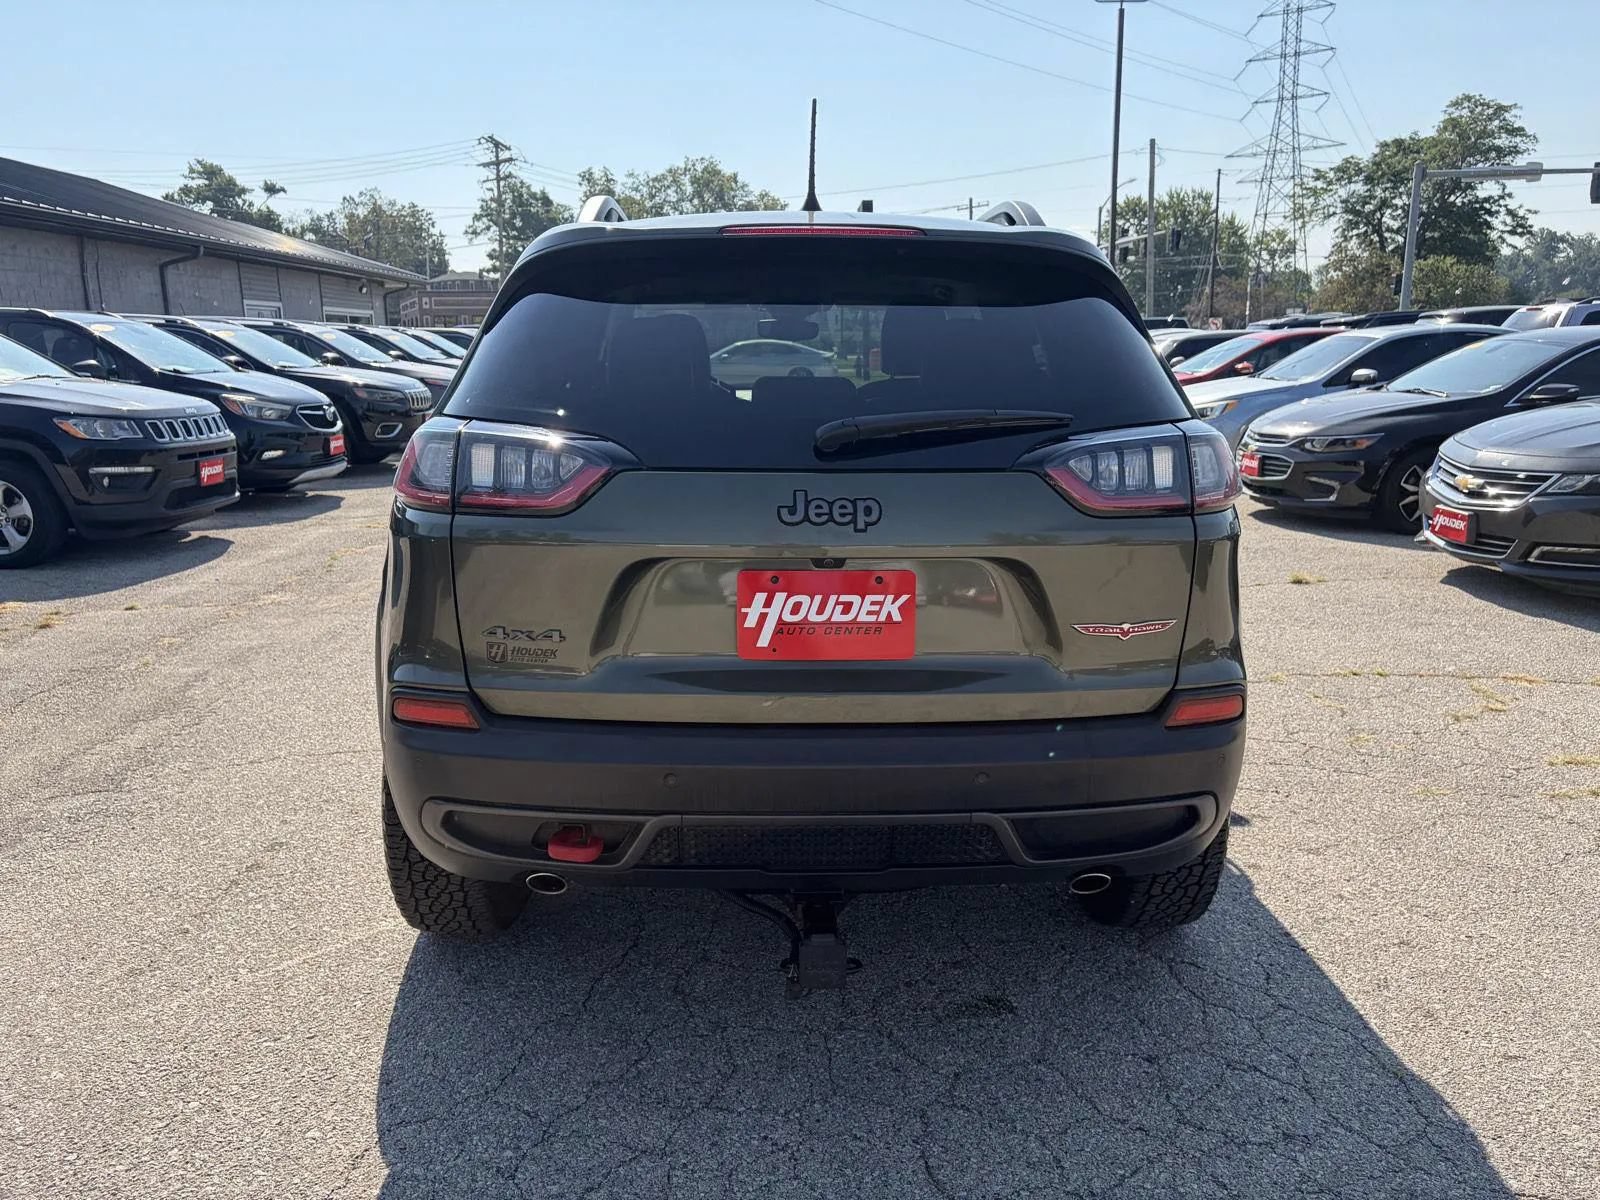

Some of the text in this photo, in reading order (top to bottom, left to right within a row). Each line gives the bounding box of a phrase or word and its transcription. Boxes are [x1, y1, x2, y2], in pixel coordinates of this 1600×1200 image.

[777, 489, 882, 533] Jeep
[1433, 514, 1466, 531] HOUDEK
[741, 592, 911, 648] HOUDEK
[776, 626, 883, 635] AUTO CENTER
[510, 646, 558, 657] HOUDEK
